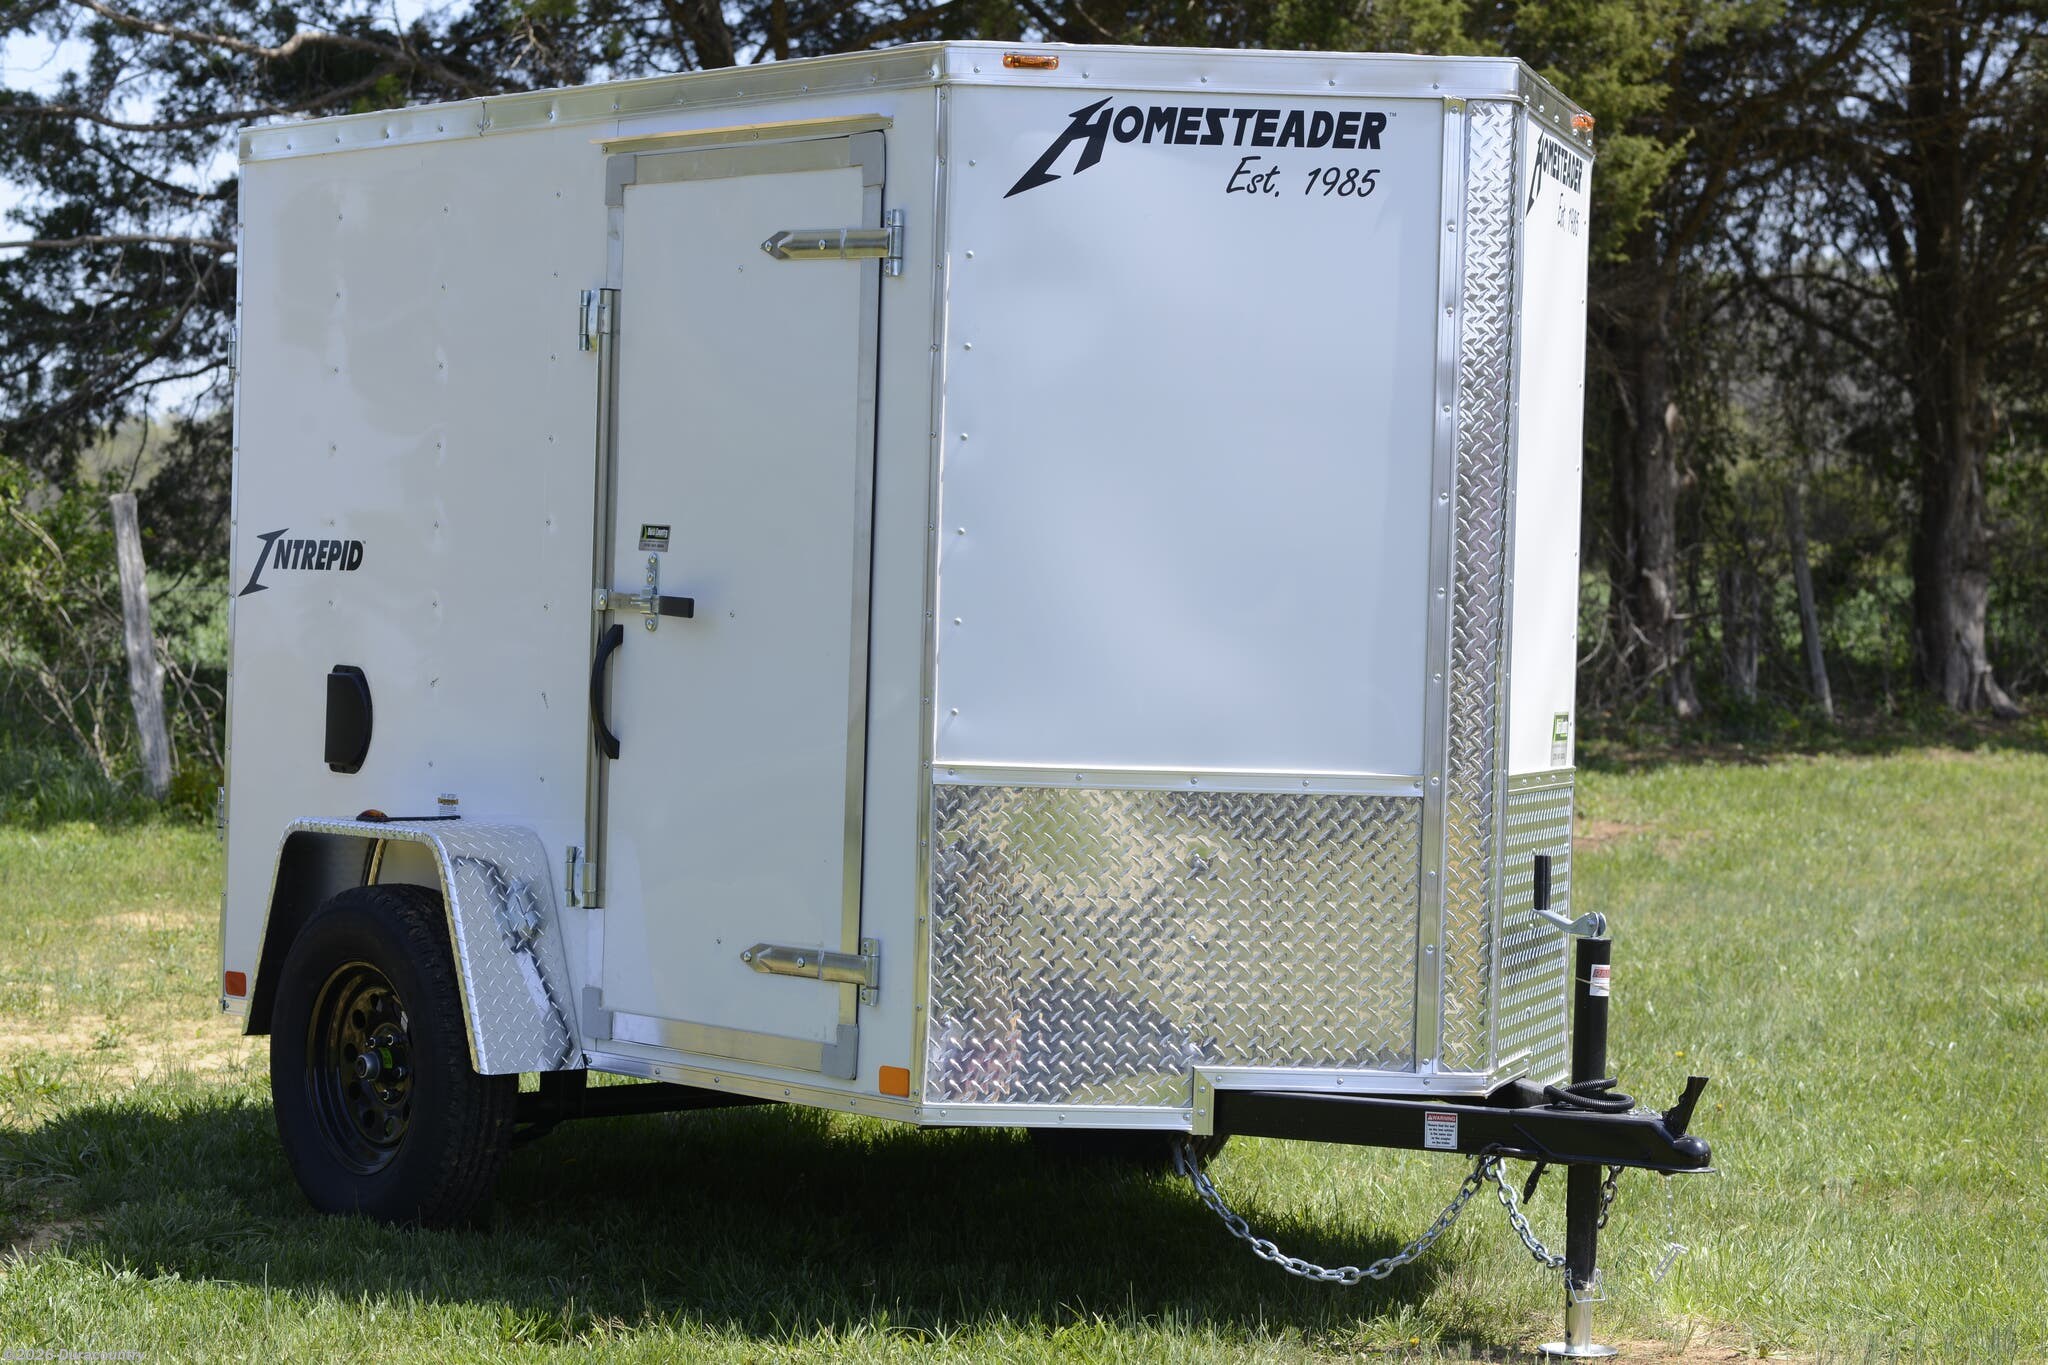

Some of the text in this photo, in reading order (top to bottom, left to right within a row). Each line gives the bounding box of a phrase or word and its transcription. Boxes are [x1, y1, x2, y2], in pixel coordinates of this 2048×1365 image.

[1003, 96, 1387, 198] HOMESTEADER
[1226, 155, 1381, 198] Est. 1985
[238, 528, 364, 597] INTREPID
